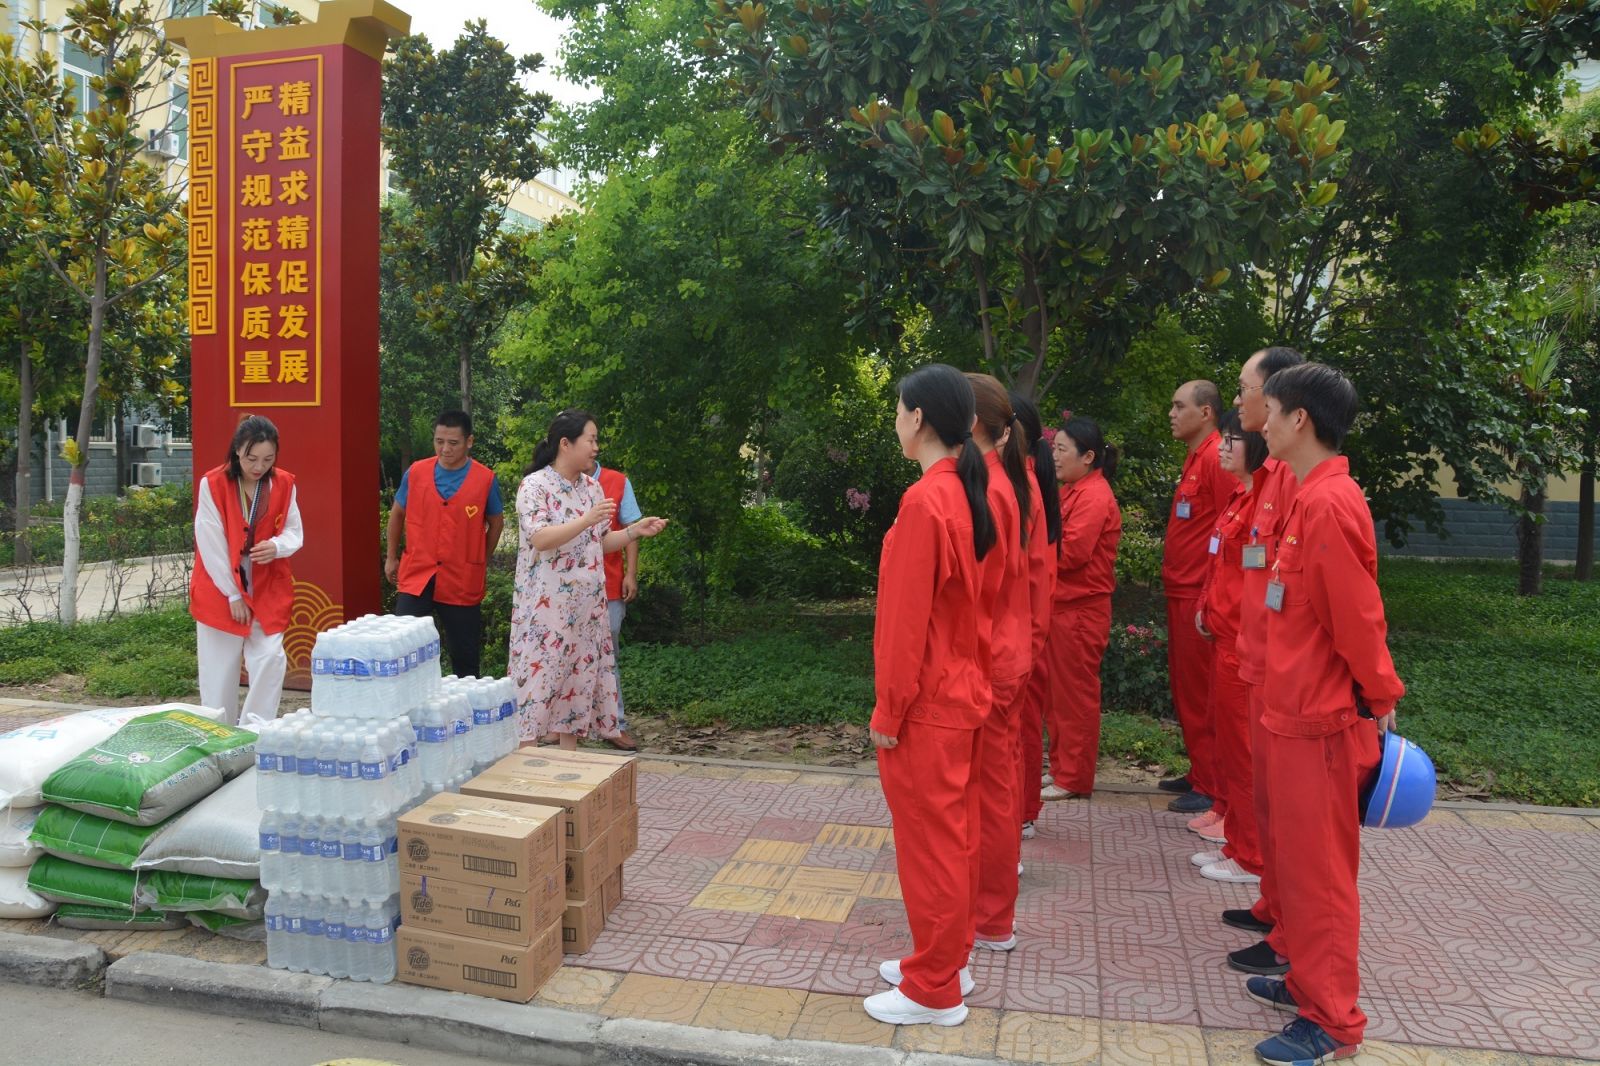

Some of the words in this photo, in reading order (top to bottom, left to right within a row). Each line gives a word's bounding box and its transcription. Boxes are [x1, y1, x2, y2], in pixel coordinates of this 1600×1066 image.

[240, 84, 273, 384] 严守规范保质量
[277, 80, 312, 384] 精益求精促发展
[408, 845, 427, 858] Tide
[504, 897, 521, 908] P&G
[500, 954, 518, 965] P&G
